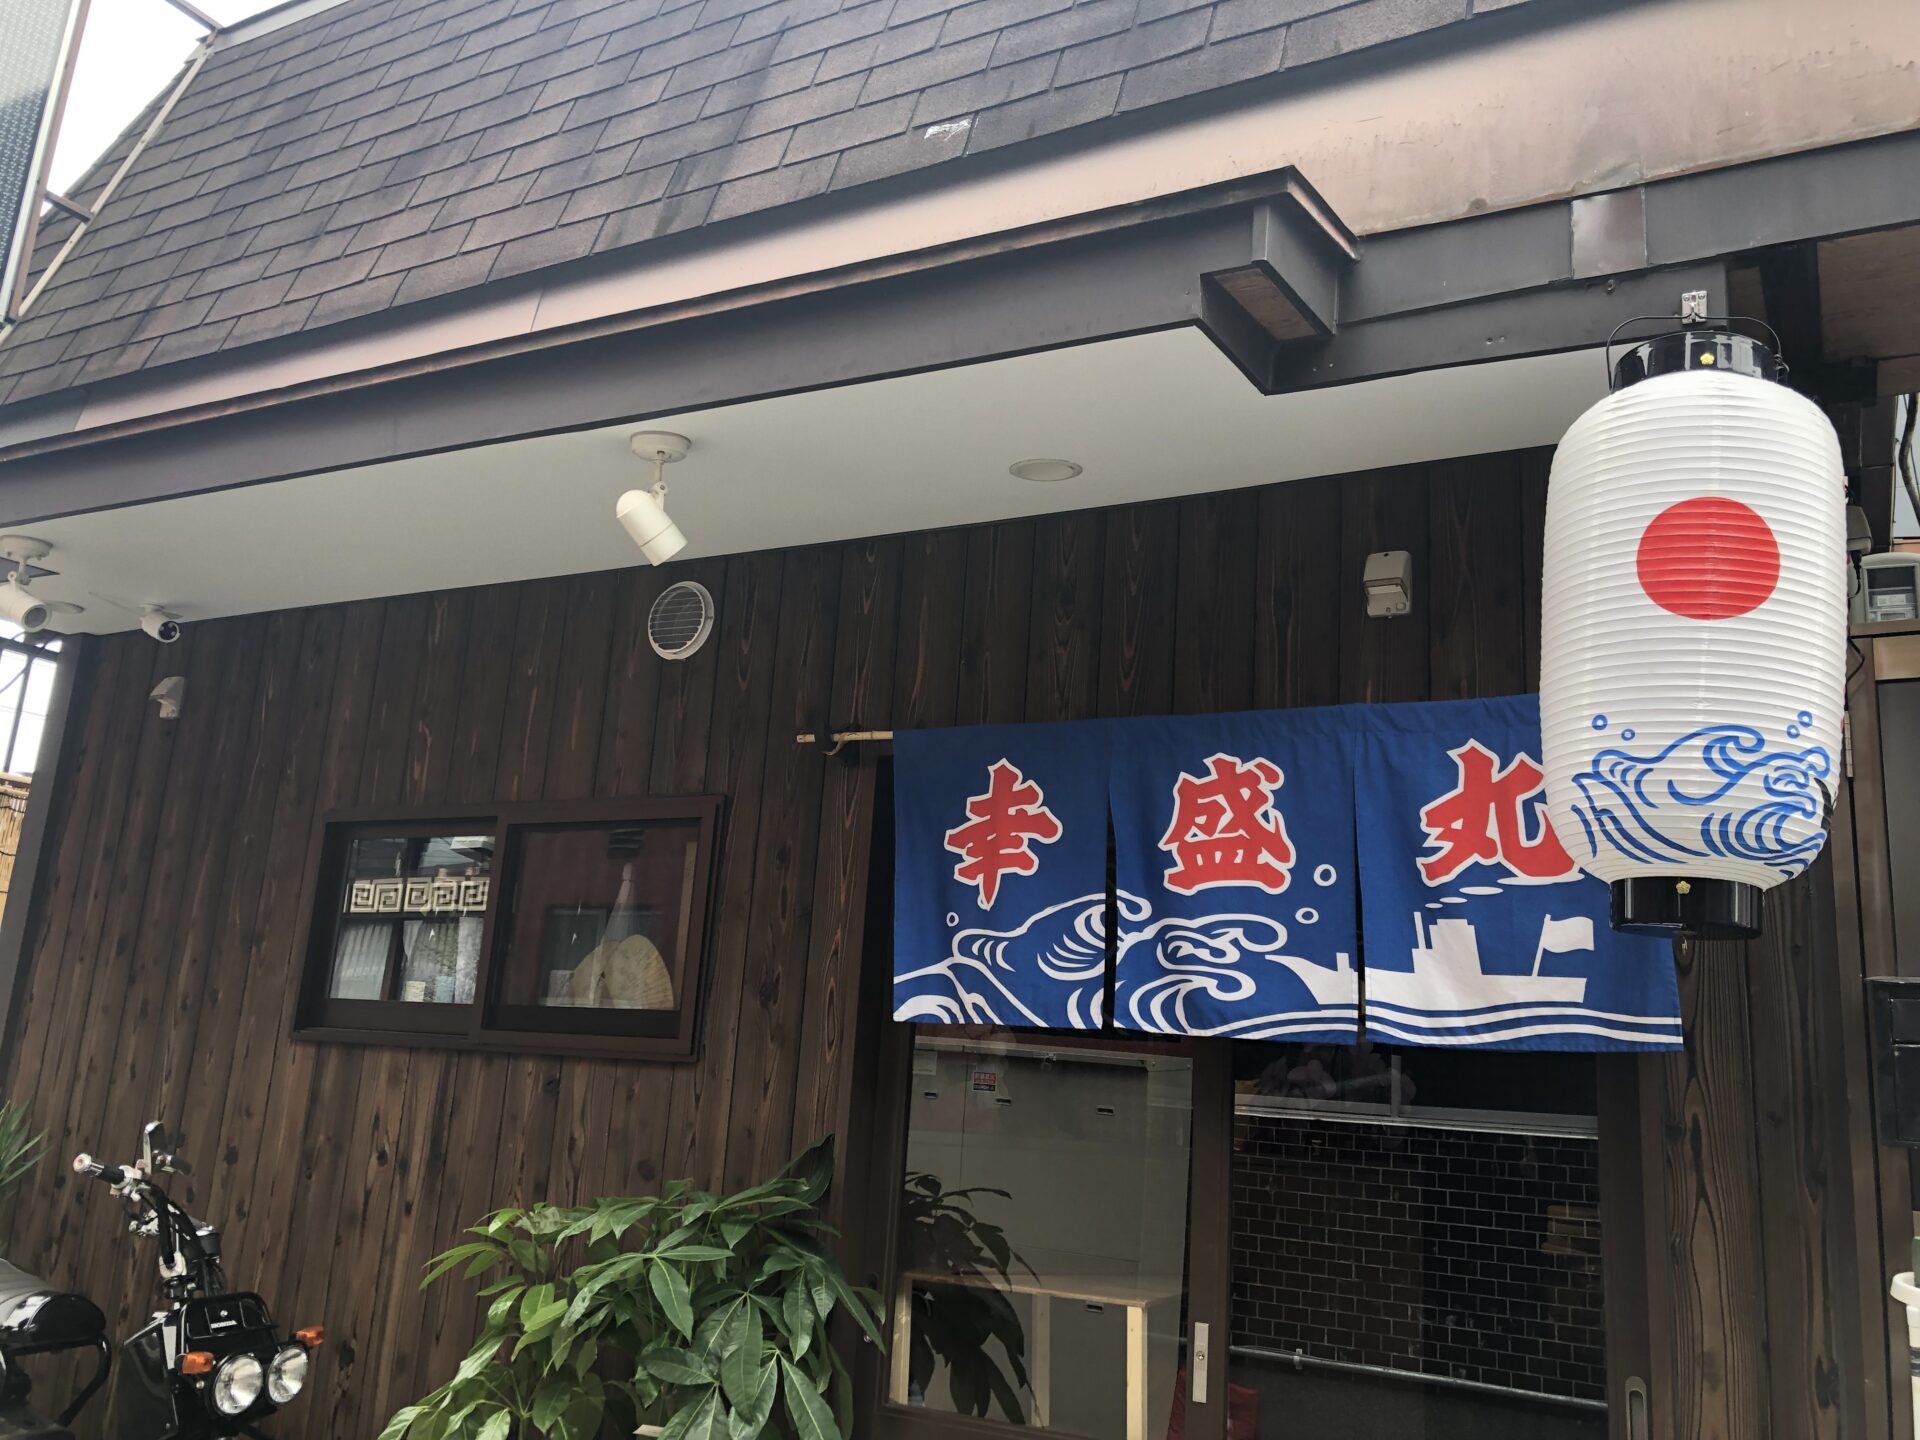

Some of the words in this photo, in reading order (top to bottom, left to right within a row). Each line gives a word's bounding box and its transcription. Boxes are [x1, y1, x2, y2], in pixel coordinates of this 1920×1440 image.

[944, 739, 1578, 910] 幸盛丸
[210, 1320, 238, 1329] HONDA
